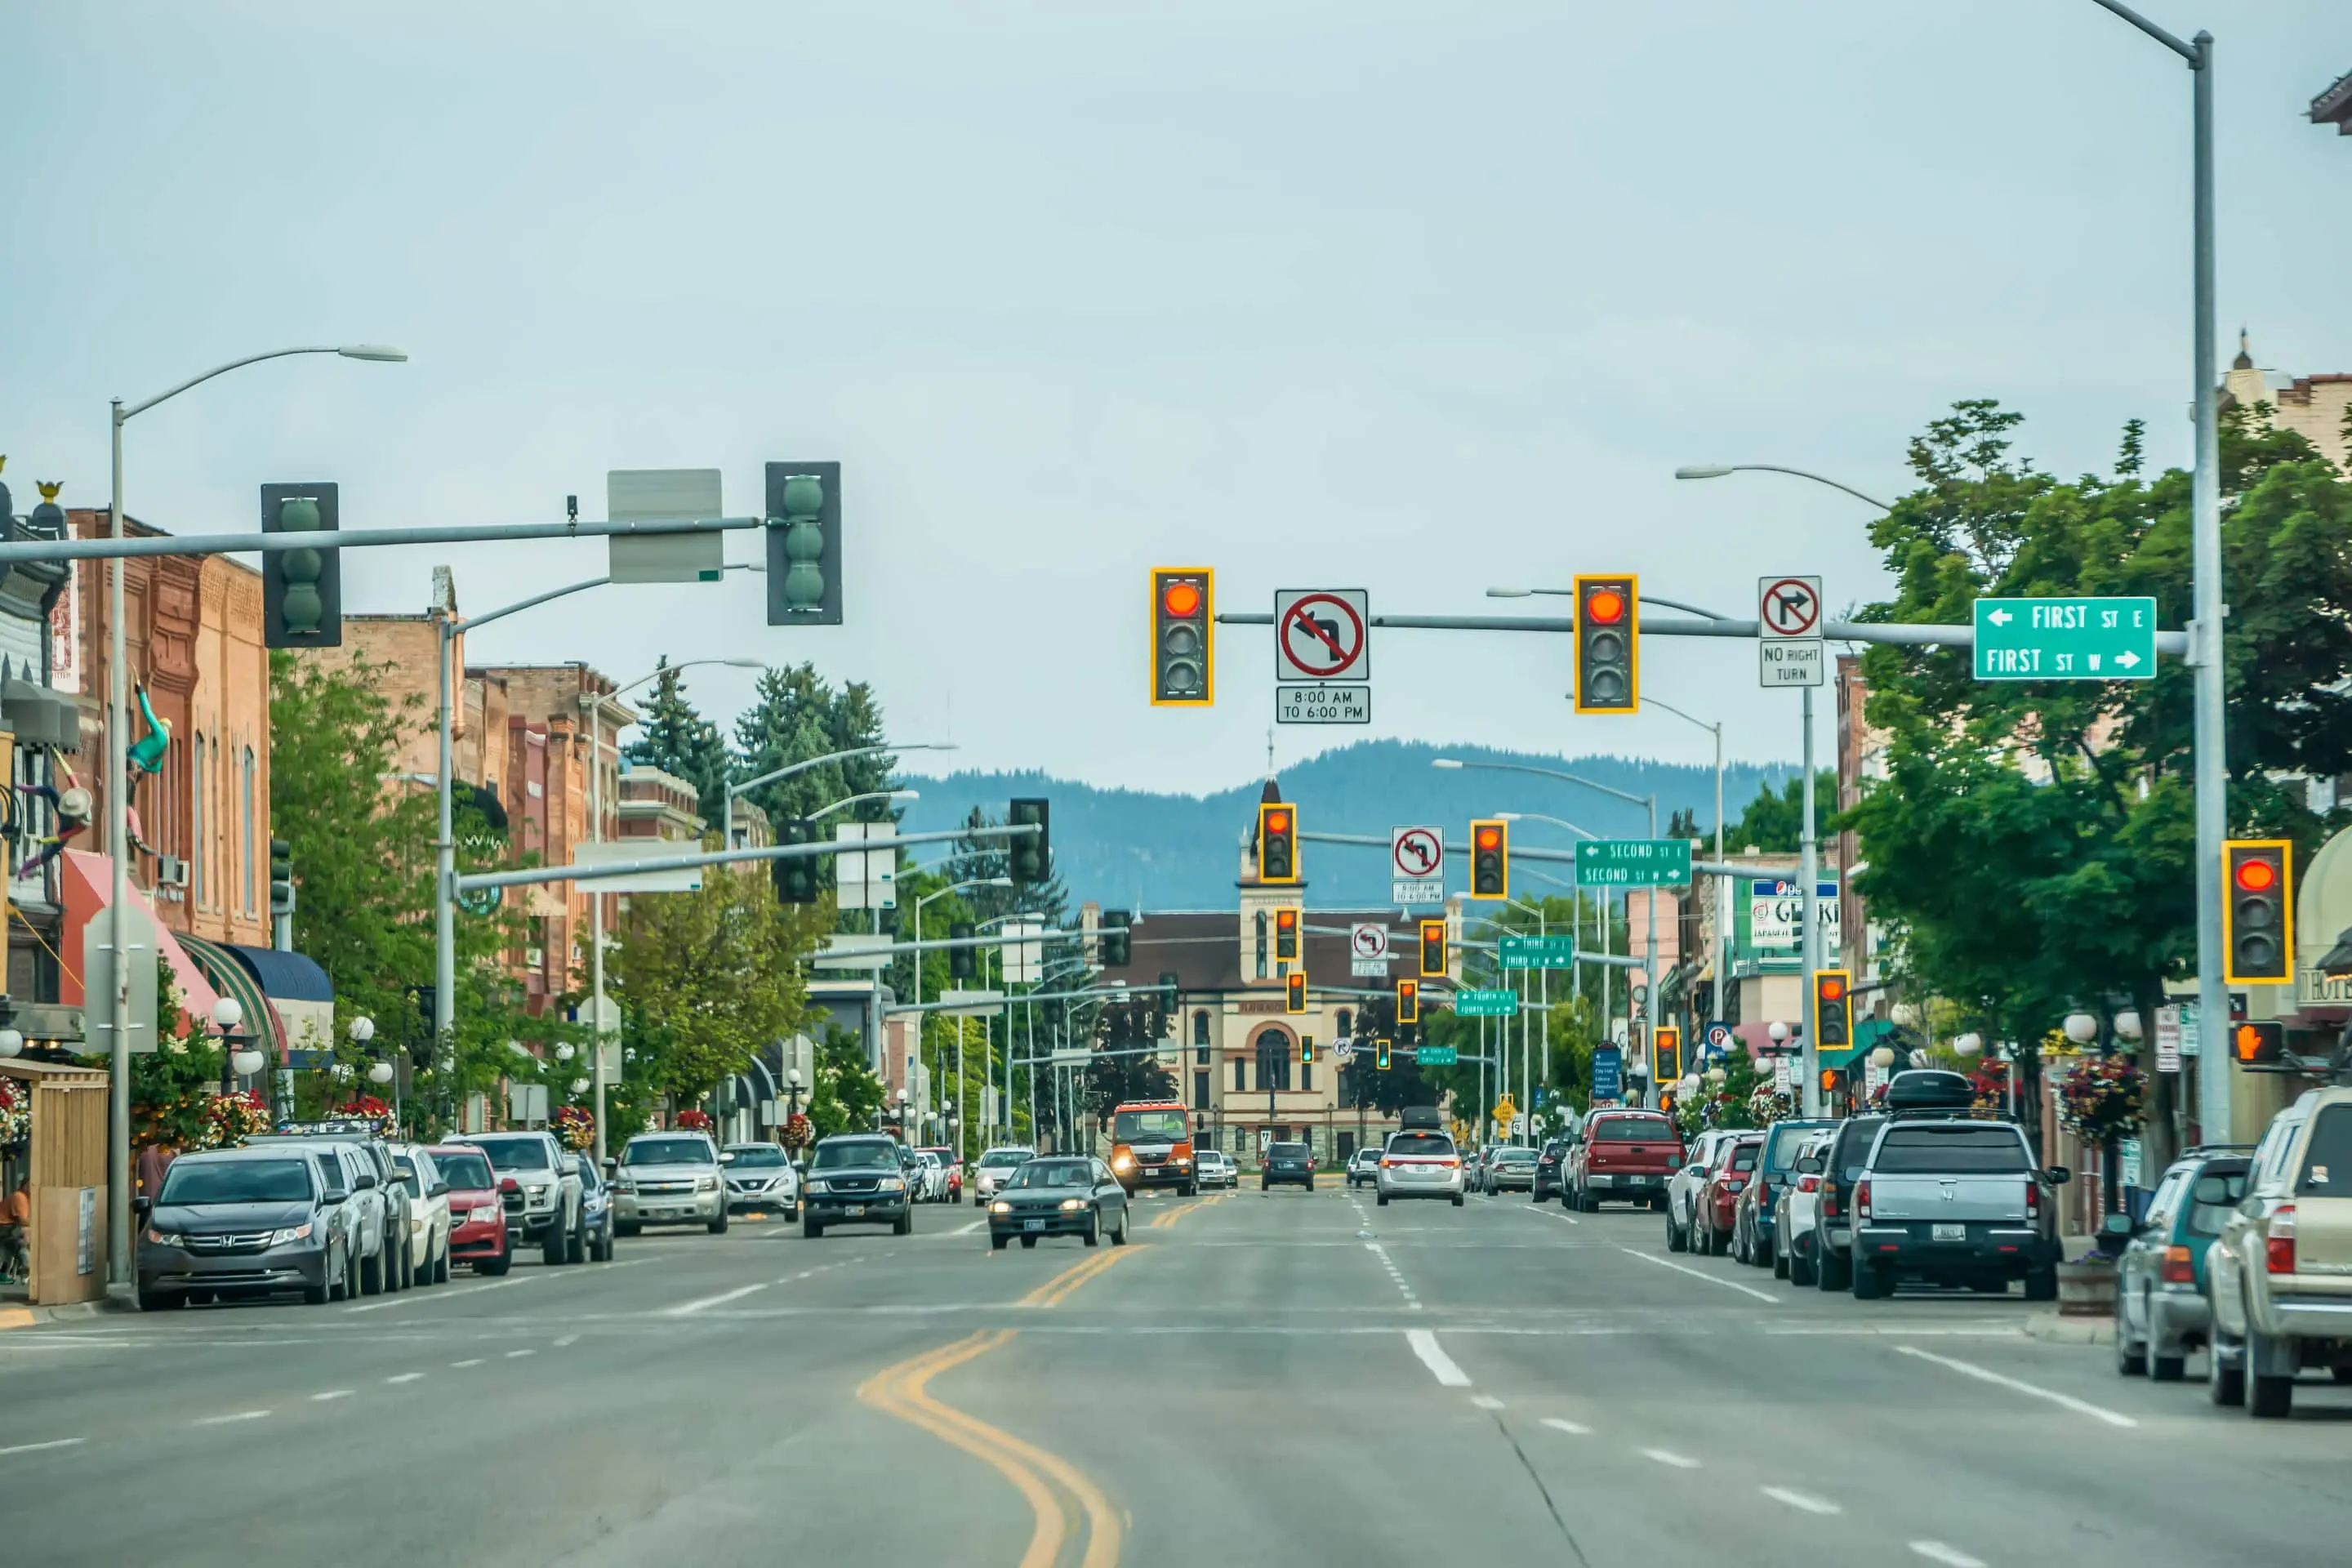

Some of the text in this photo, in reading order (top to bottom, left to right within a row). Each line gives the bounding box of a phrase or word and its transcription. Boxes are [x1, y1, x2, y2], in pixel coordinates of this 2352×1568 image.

[2032, 605, 2144, 629] FIRST ST E
[1765, 647, 1818, 662] NO RIGHT
[1986, 648, 2101, 672] FIRST ST W
[1777, 668, 1806, 679] TURN
[1294, 691, 1352, 704] 8:00 AM
[1284, 706, 1362, 718] TO 6:00 PM
[1610, 844, 1682, 858] SECOND ST E
[1585, 867, 1659, 883] SECOND ST W
[1523, 939, 1544, 950] THIRD
[1506, 955, 1528, 967] THIRD
[1714, 1030, 1723, 1044] P
